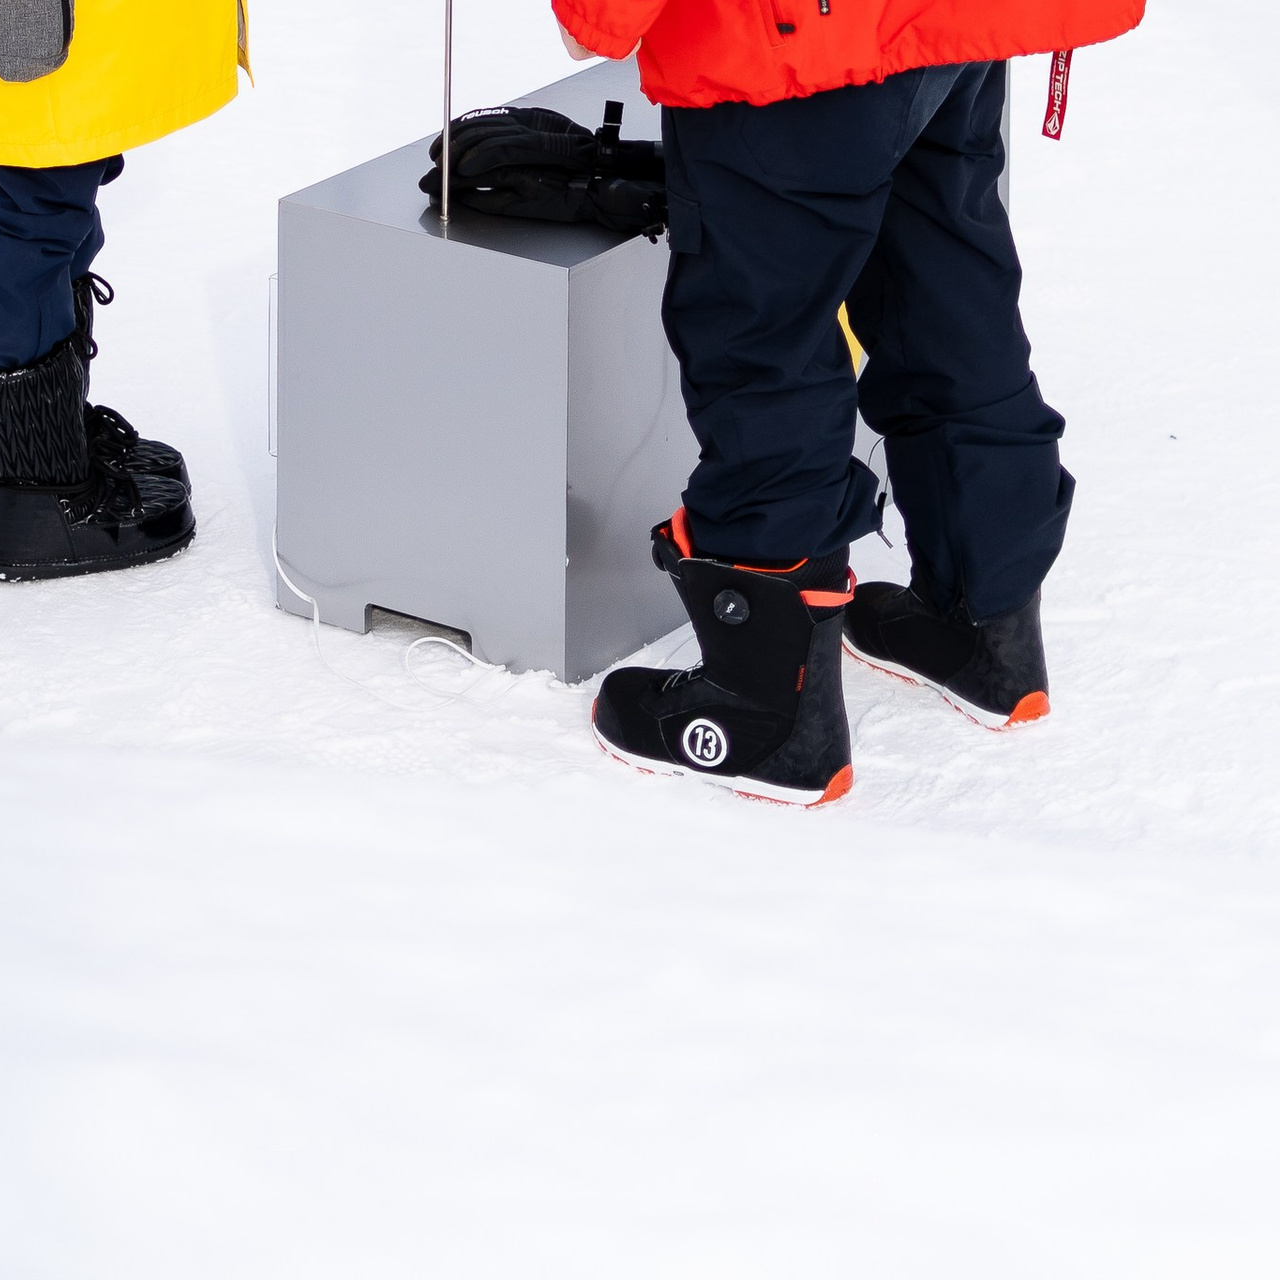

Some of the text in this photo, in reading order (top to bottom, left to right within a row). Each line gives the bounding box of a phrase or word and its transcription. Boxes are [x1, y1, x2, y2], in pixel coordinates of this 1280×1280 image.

[1053, 73, 1064, 111] TECH
[460, 107, 510, 122] reusch
[695, 726, 718, 760] 13
